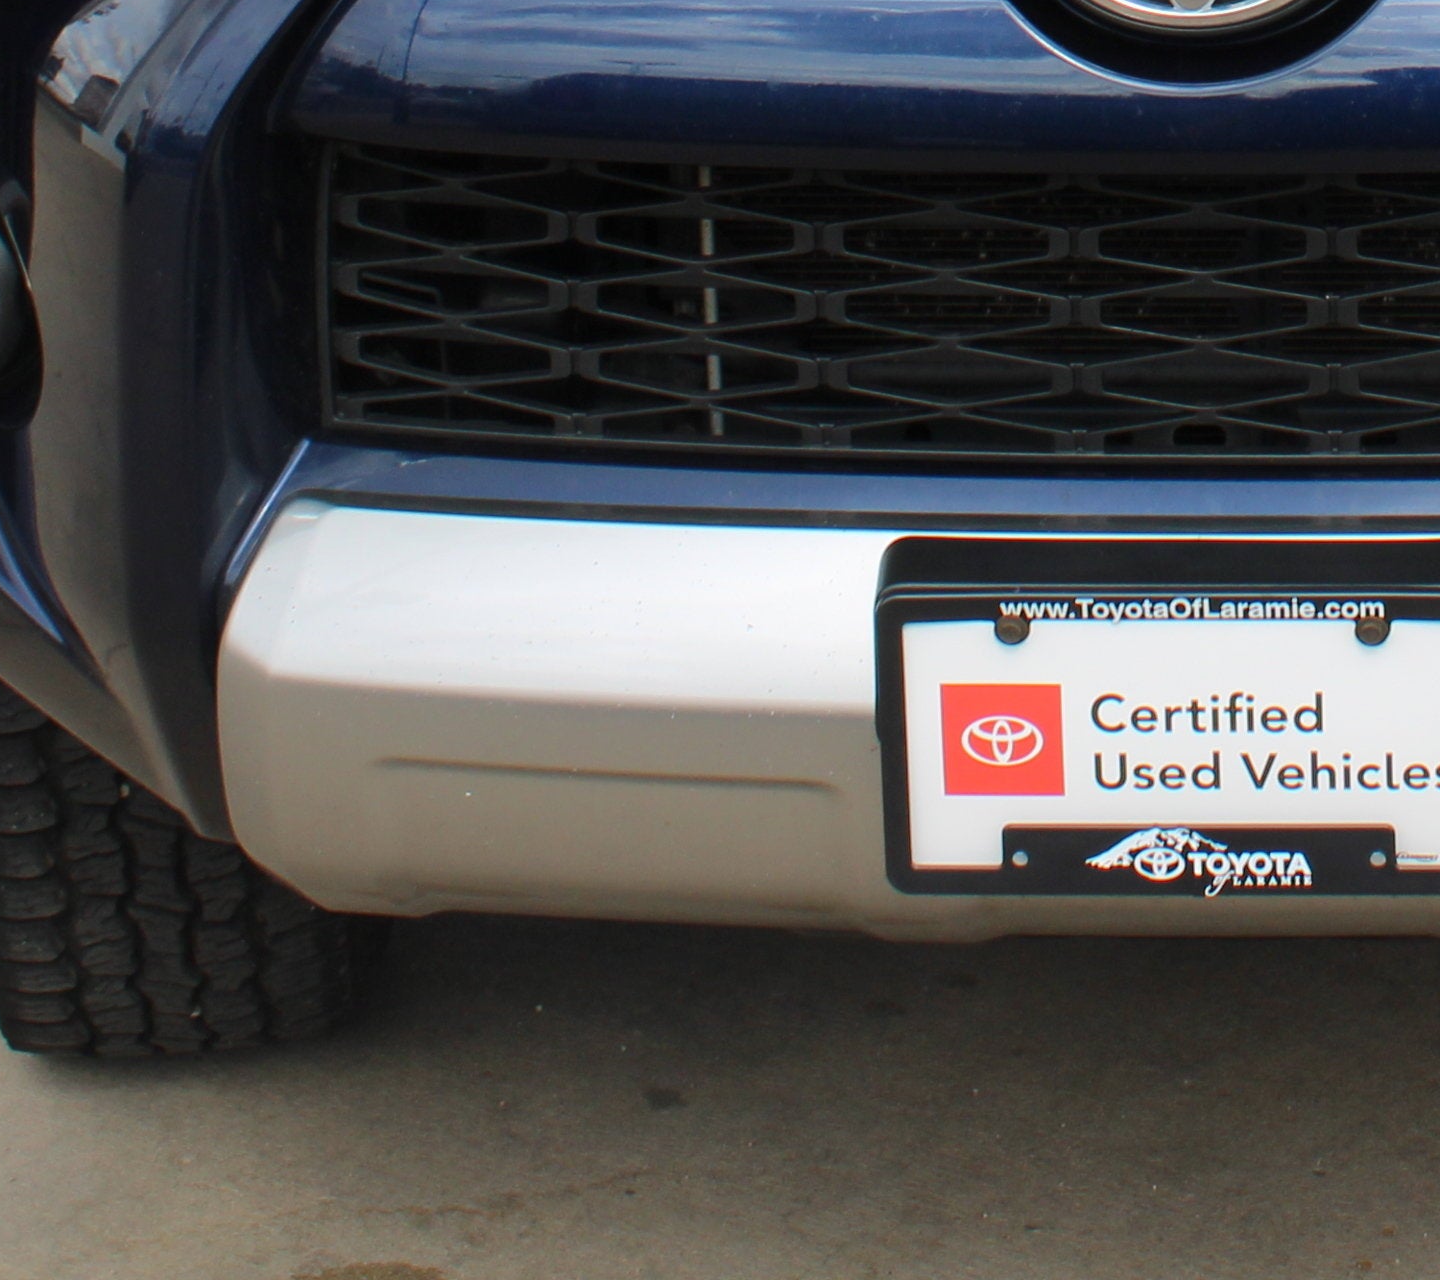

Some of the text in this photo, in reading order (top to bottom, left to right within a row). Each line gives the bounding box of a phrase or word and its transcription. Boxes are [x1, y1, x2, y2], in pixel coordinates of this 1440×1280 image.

[999, 597, 1387, 625] www.ToyotaOfLaramie.com
[1090, 692, 1325, 735] Certified
[1093, 751, 1222, 791] Used
[1187, 851, 1312, 877] TOYOTA
[1232, 875, 1313, 887] LARAMIE
